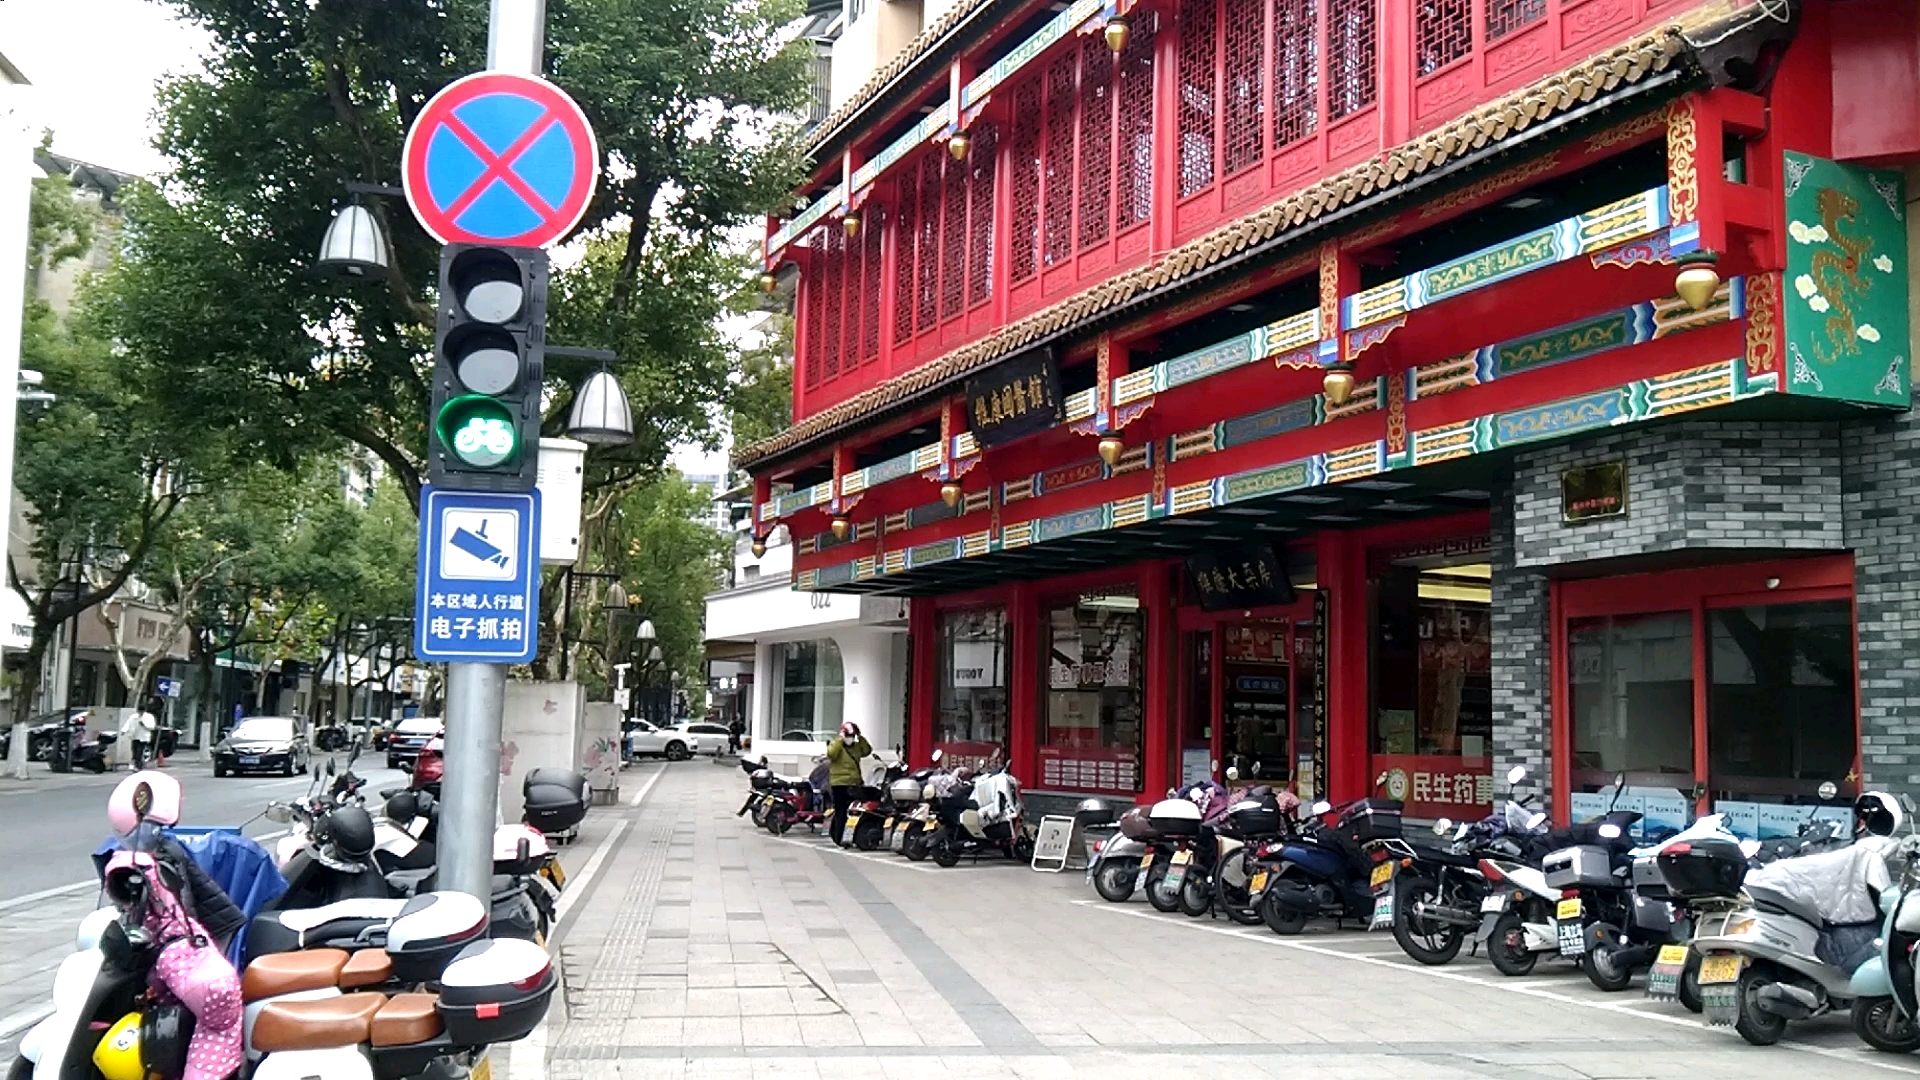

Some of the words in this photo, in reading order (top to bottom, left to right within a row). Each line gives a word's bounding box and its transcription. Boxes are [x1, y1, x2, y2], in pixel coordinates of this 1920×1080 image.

[430, 592, 524, 610] 本区域人行道
[430, 616, 522, 640] 电子抓拍
[1413, 772, 1494, 805] 民生药事
